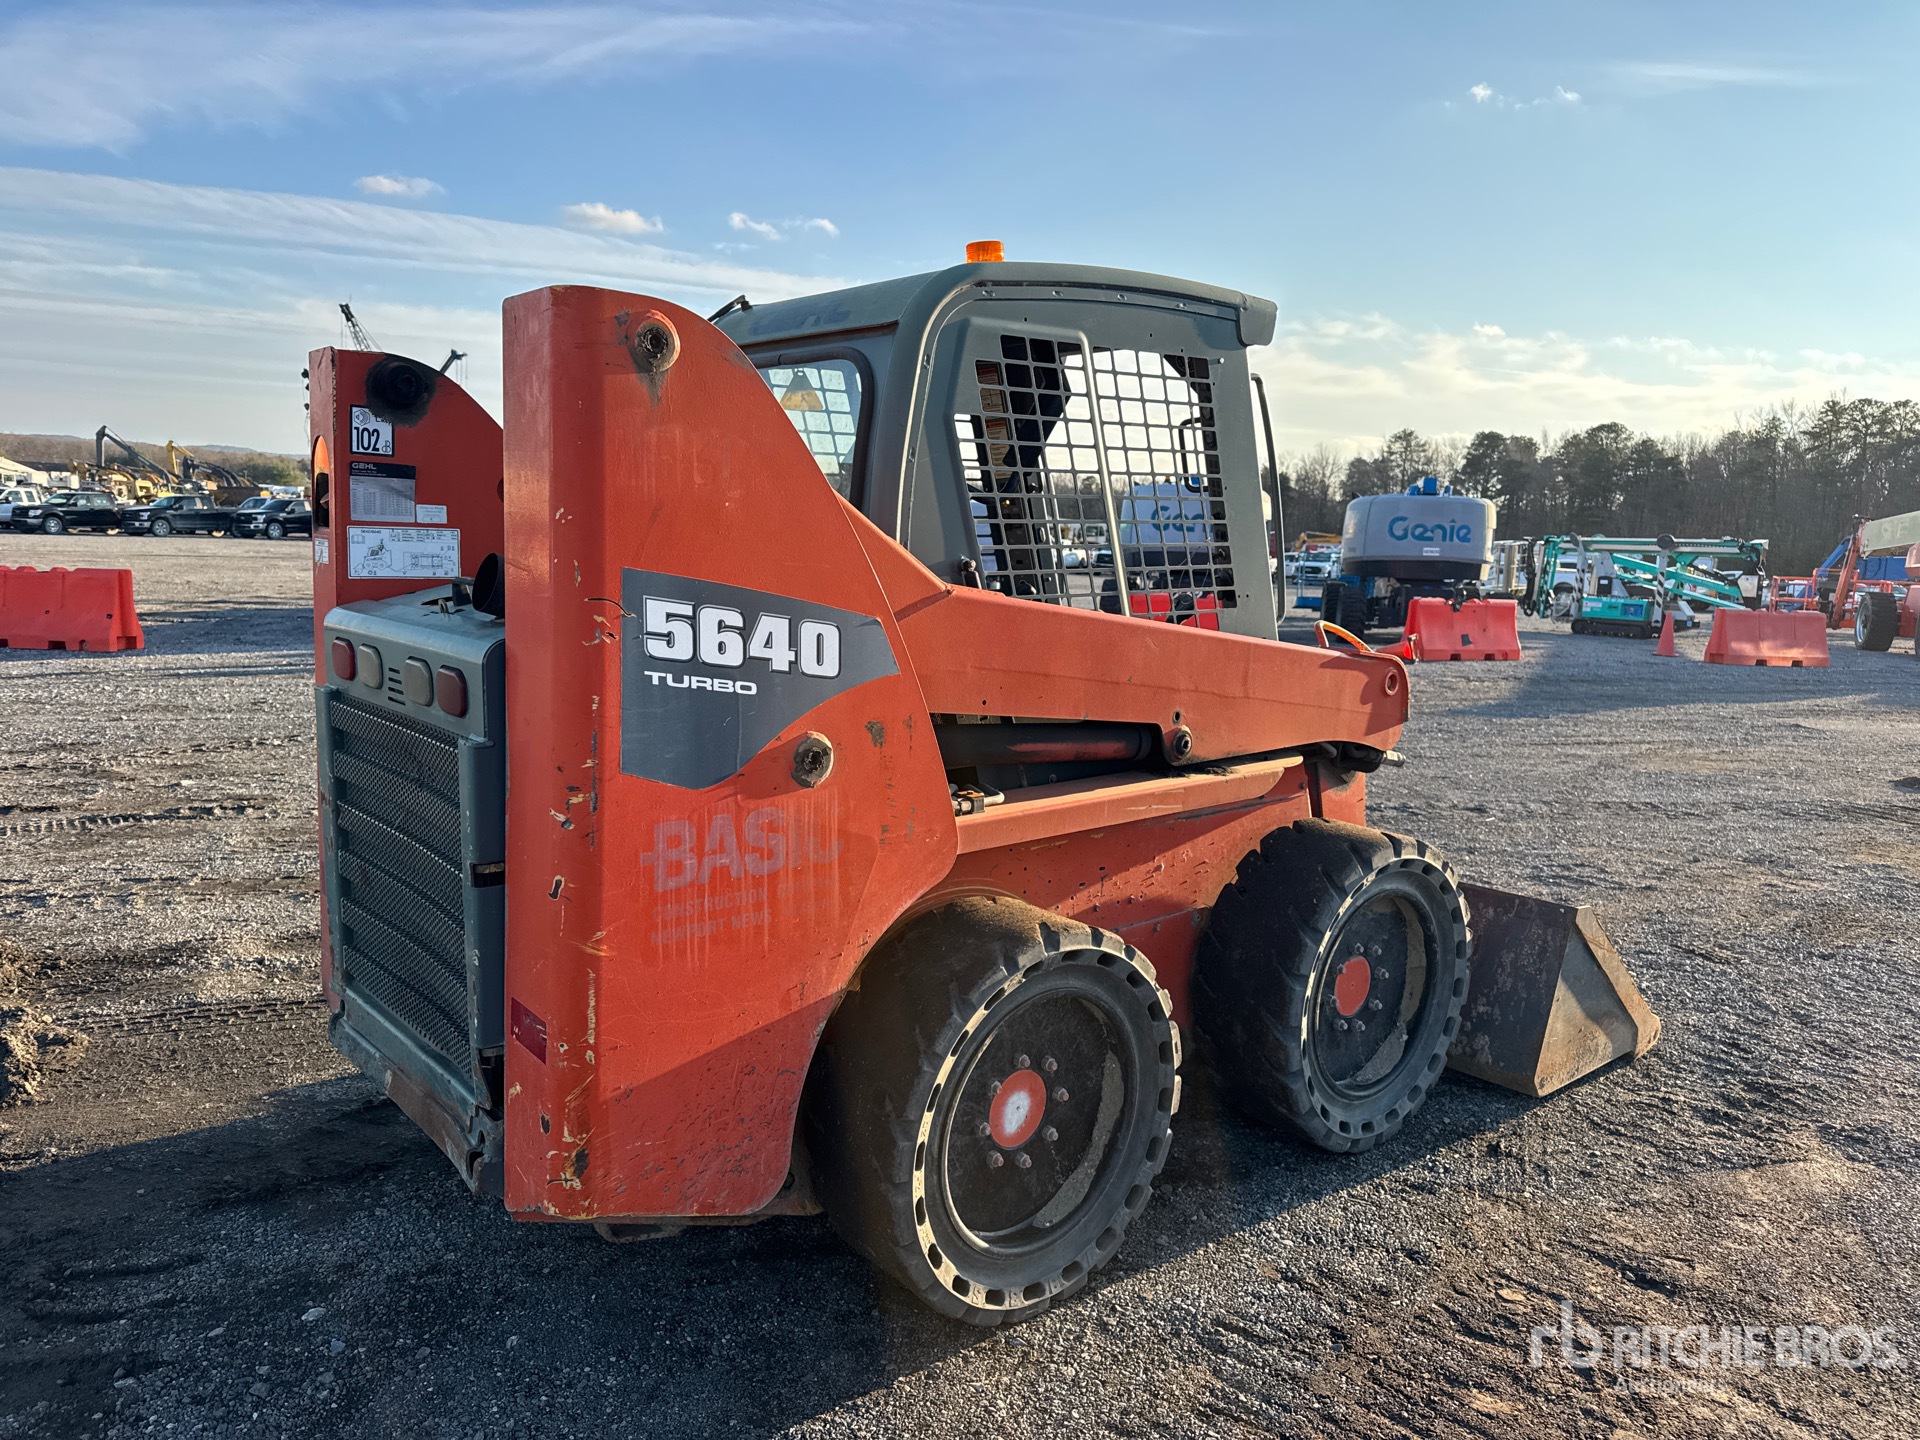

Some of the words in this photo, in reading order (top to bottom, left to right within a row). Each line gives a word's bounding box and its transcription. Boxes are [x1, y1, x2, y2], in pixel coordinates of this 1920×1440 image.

[354, 426, 380, 452] 102
[382, 440, 391, 454] dB
[352, 462, 377, 470] GEHL
[1387, 515, 1472, 543] Genie
[642, 595, 842, 679] 5640
[644, 670, 757, 696] TURBO
[652, 887, 767, 922] CONSTRUCTION
[651, 918, 725, 945] NEWPORT
[730, 908, 772, 929] NEWS
